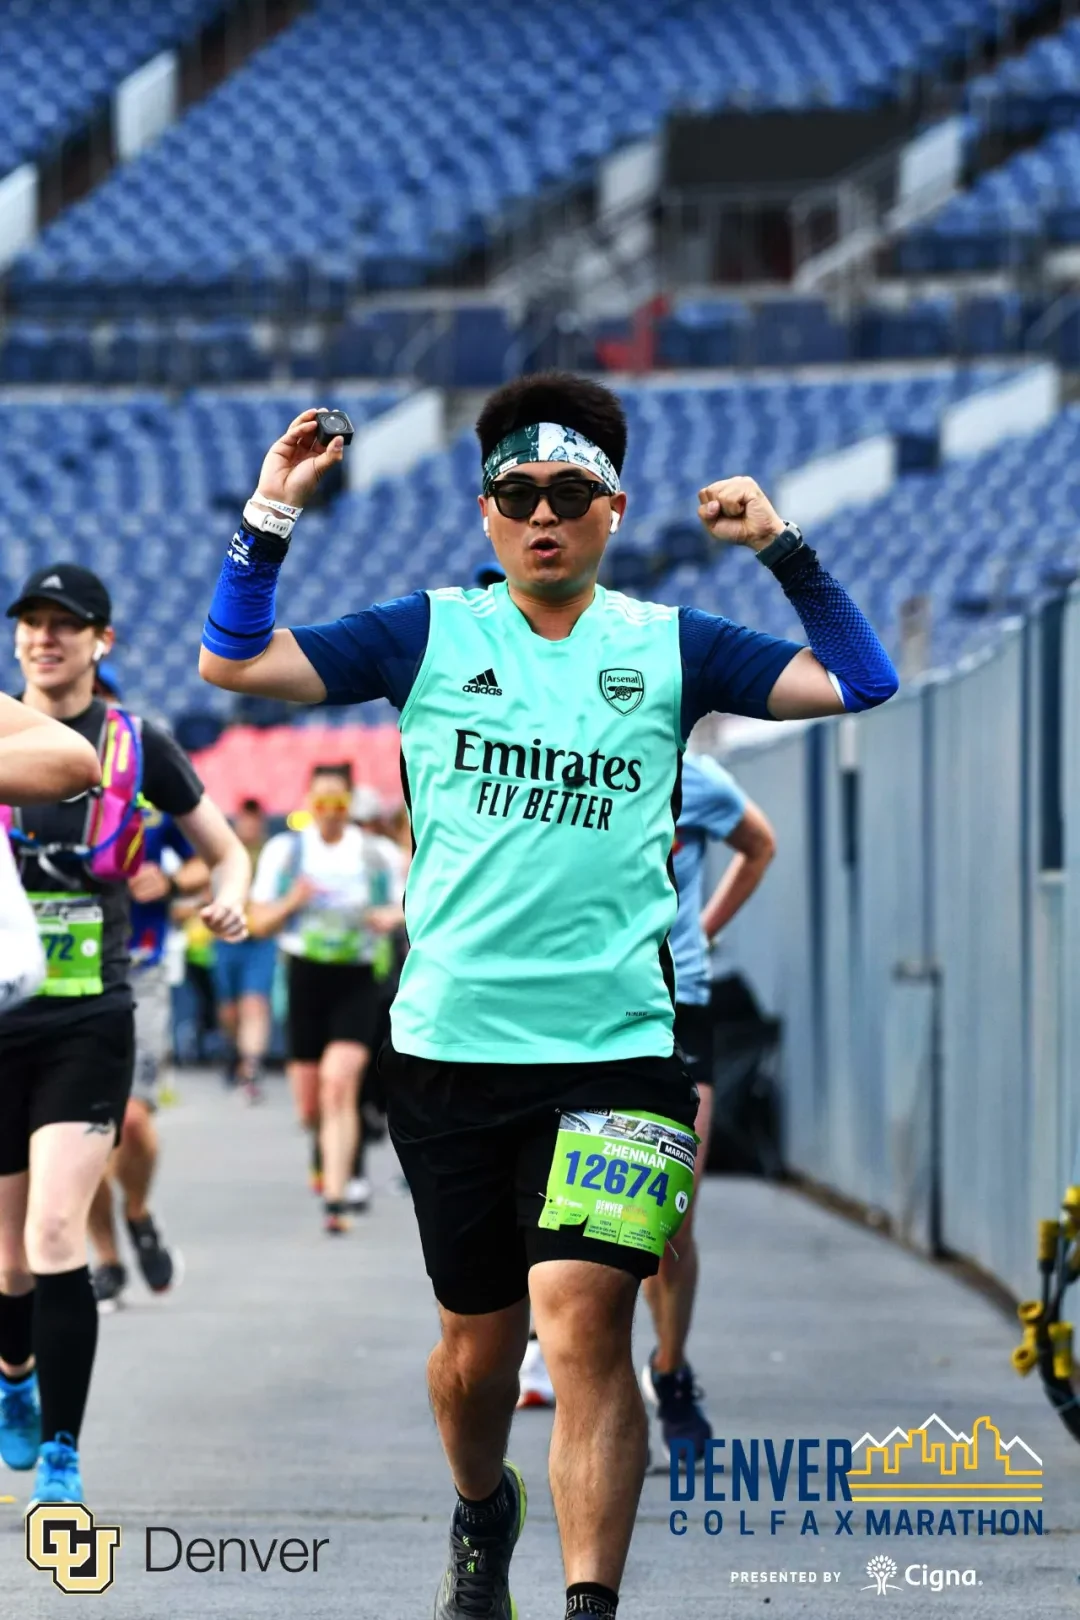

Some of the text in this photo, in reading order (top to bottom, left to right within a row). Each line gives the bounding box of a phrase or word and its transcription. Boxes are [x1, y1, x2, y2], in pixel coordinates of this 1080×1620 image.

[462, 684, 503, 696] adidas
[606, 675, 638, 684] Arsenal
[454, 729, 642, 792] Emirates
[476, 782, 614, 831] FLY BETTER
[602, 1141, 667, 1170] ZHENNAN
[664, 1144, 694, 1169] MARATHO
[565, 1150, 670, 1207] 12674
